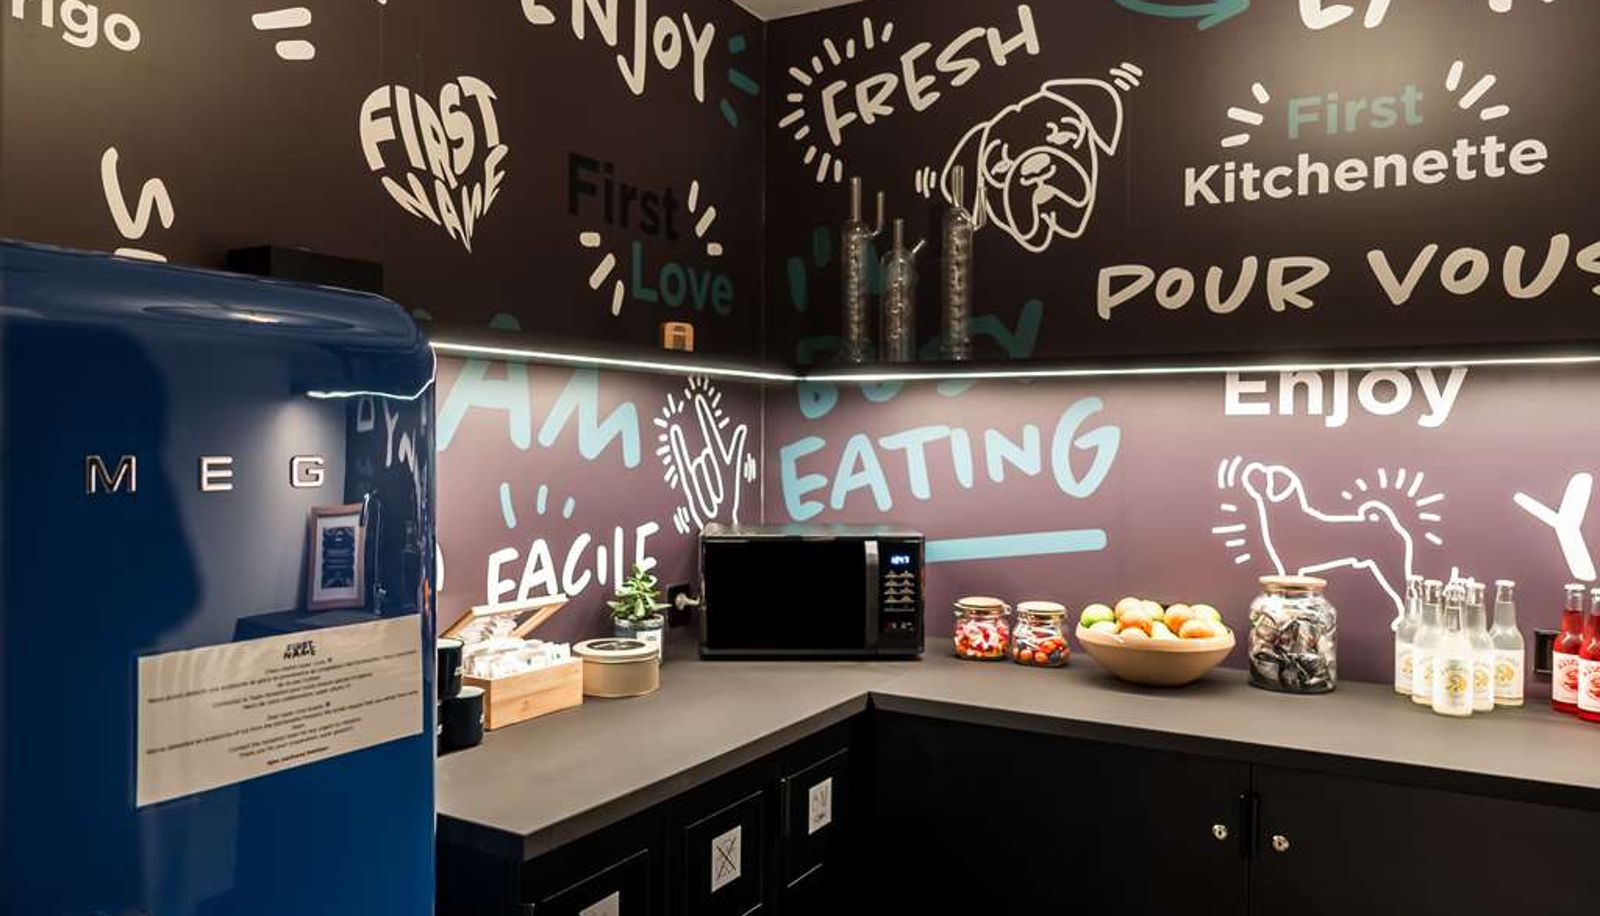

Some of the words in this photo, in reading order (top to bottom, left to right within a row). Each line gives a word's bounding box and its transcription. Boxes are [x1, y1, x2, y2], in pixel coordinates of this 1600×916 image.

[822, 4, 1040, 146] FRESH
[1287, 83, 1424, 140] First
[359, 76, 501, 190] FIRST
[1184, 135, 1548, 207] Kitchenette
[381, 143, 509, 253] NAME
[567, 152, 679, 242] First
[631, 240, 734, 315] Love
[1097, 256, 1330, 320] POUR
[1225, 367, 1469, 428] Enjoy
[780, 397, 1121, 521] EATING
[487, 522, 661, 606] FACILE
